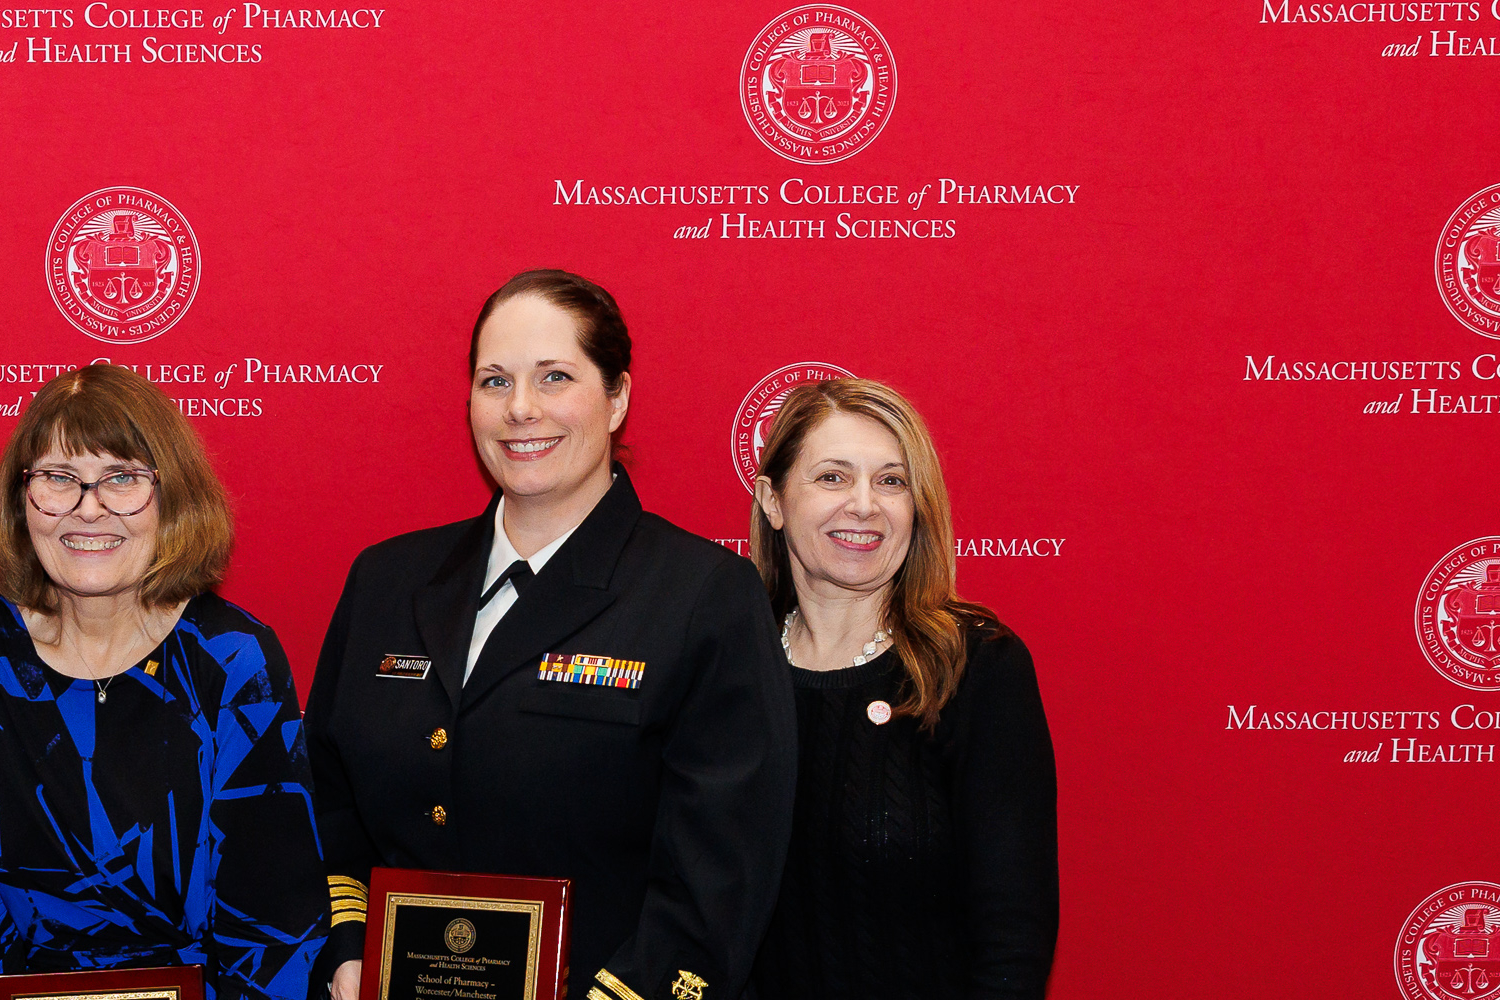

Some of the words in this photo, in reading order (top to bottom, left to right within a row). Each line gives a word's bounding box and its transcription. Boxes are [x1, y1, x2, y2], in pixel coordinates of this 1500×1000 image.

[84, 2, 204, 28] COLLEGE
[212, 8, 233, 34] of
[243, 3, 385, 28] PHARMACY
[1259, 0, 1480, 23] MASSACHUSETTS
[26, 37, 131, 62] HEALTH
[142, 37, 262, 63] SCIENCES
[1382, 36, 1422, 57] and
[553, 180, 768, 205] MASSACHUSETTS
[780, 178, 899, 204] COLLEGE
[908, 184, 930, 210] of
[938, 179, 1080, 204] PHARMACY
[674, 218, 712, 238] and
[720, 213, 825, 238] HEALTH
[836, 213, 955, 238] SCIENCES
[214, 363, 238, 389] of
[244, 358, 383, 383] PHARMACY
[395, 659, 429, 671] SANTORO
[1225, 705, 1439, 729] MASSACHUSETTS
[1344, 743, 1382, 762] and
[1390, 738, 1494, 762] HEALTH
[415, 985, 497, 1000] Worcester/Manchester
[417, 974, 443, 984] School
[444, 976, 453, 985] of
[453, 976, 489, 989] Pharmacy
